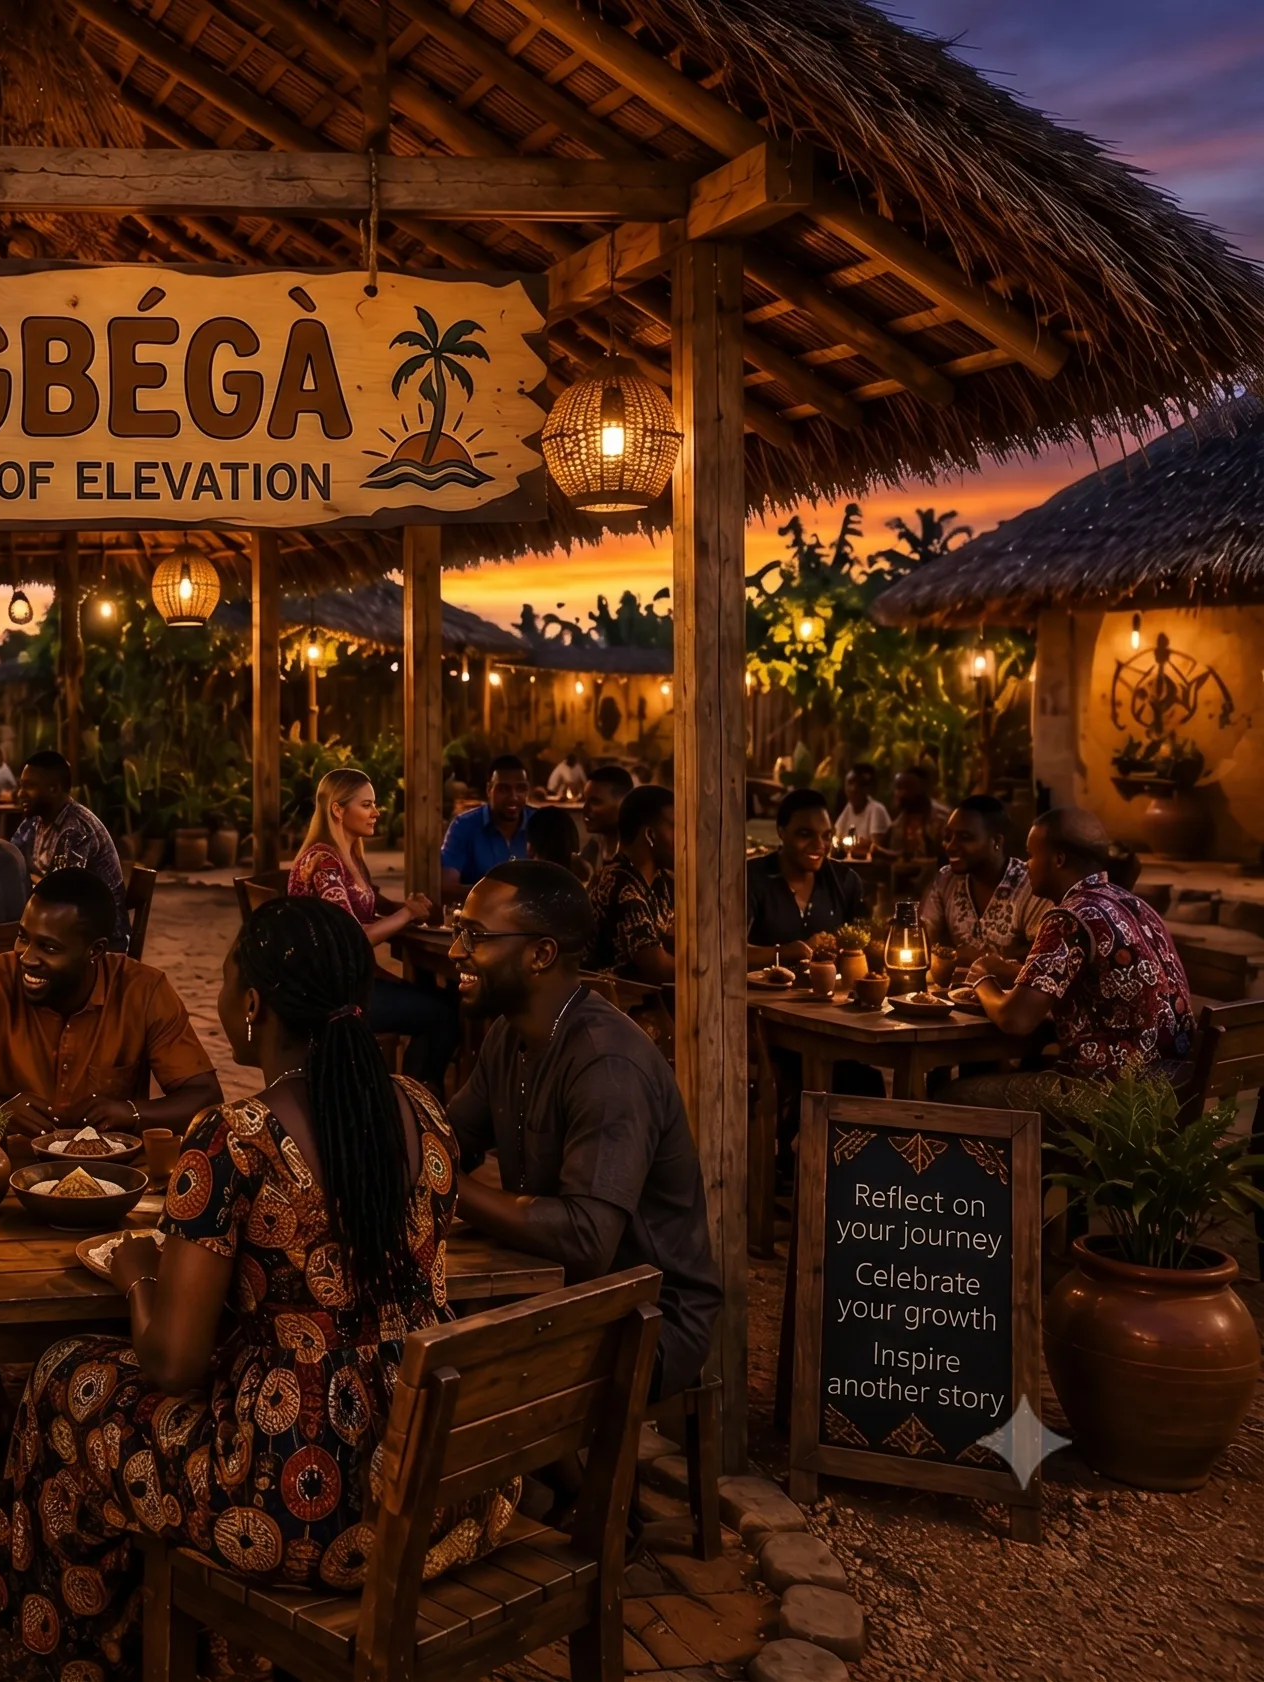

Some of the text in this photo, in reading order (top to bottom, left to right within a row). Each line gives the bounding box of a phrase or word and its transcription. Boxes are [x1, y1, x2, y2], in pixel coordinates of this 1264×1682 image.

[76, 461, 331, 502] ELEVATION
[854, 1182, 986, 1219] Reflect on
[836, 1219, 1003, 1260] your journey
[855, 1261, 982, 1297] Celebrate
[837, 1298, 997, 1333] your growth
[873, 1340, 962, 1376] Inspire
[826, 1376, 1005, 1419] another story
